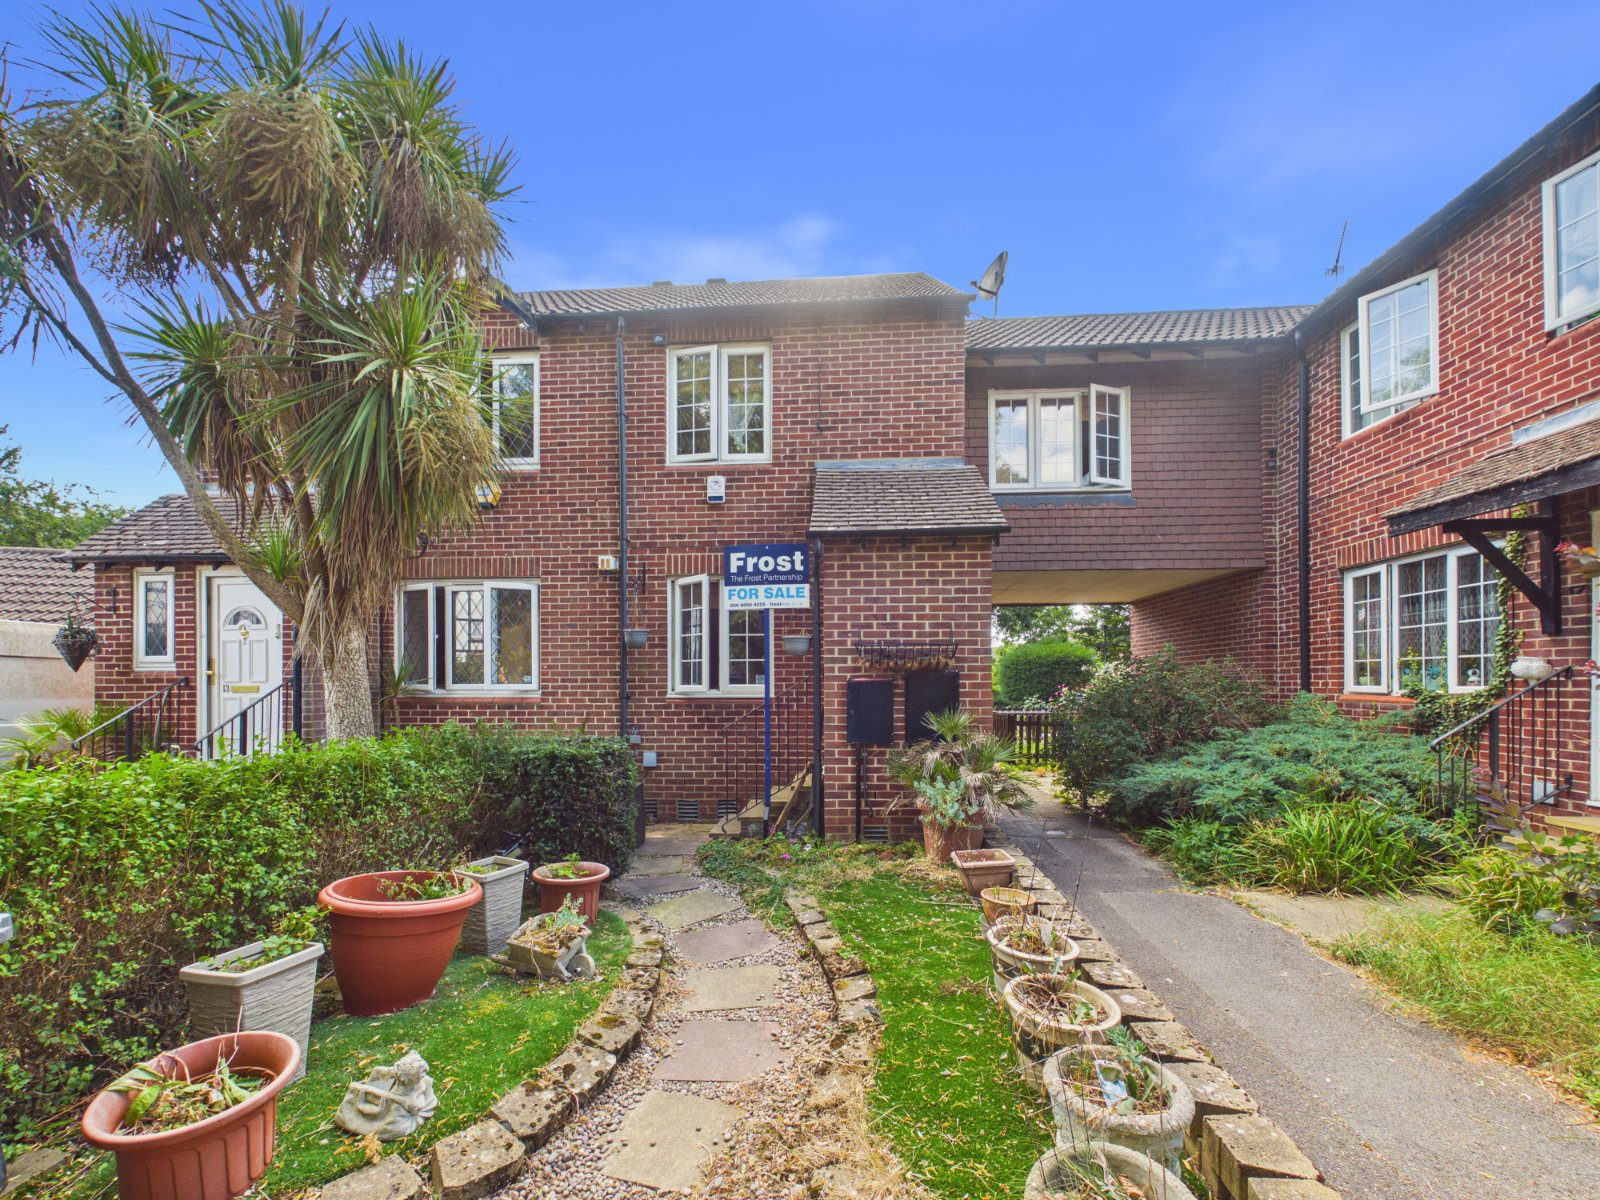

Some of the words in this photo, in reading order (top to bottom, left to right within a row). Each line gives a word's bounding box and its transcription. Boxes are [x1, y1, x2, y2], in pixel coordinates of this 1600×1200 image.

[729, 551, 804, 573] Frost
[744, 574, 762, 582] Frost
[763, 573, 803, 582] Partnership
[728, 588, 759, 600] FOR
[764, 586, 805, 599] SALE
